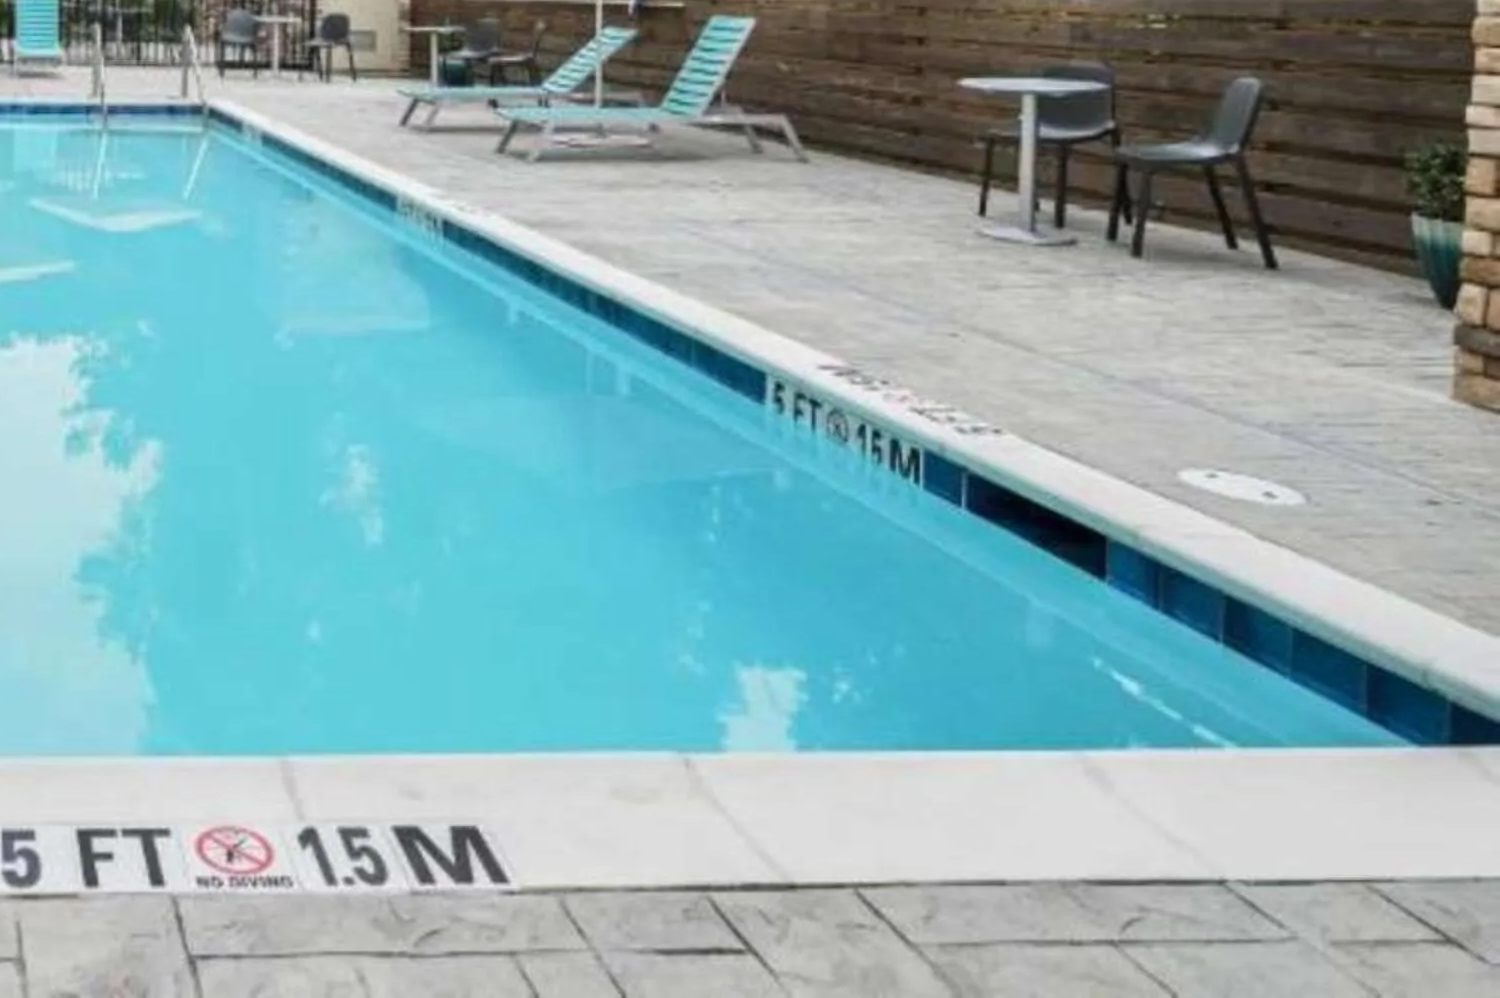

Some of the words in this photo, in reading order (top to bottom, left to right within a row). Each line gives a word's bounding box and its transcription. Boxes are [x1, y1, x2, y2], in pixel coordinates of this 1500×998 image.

[793, 392, 822, 432] FT
[0, 828, 42, 888] 5
[76, 828, 171, 887] FT
